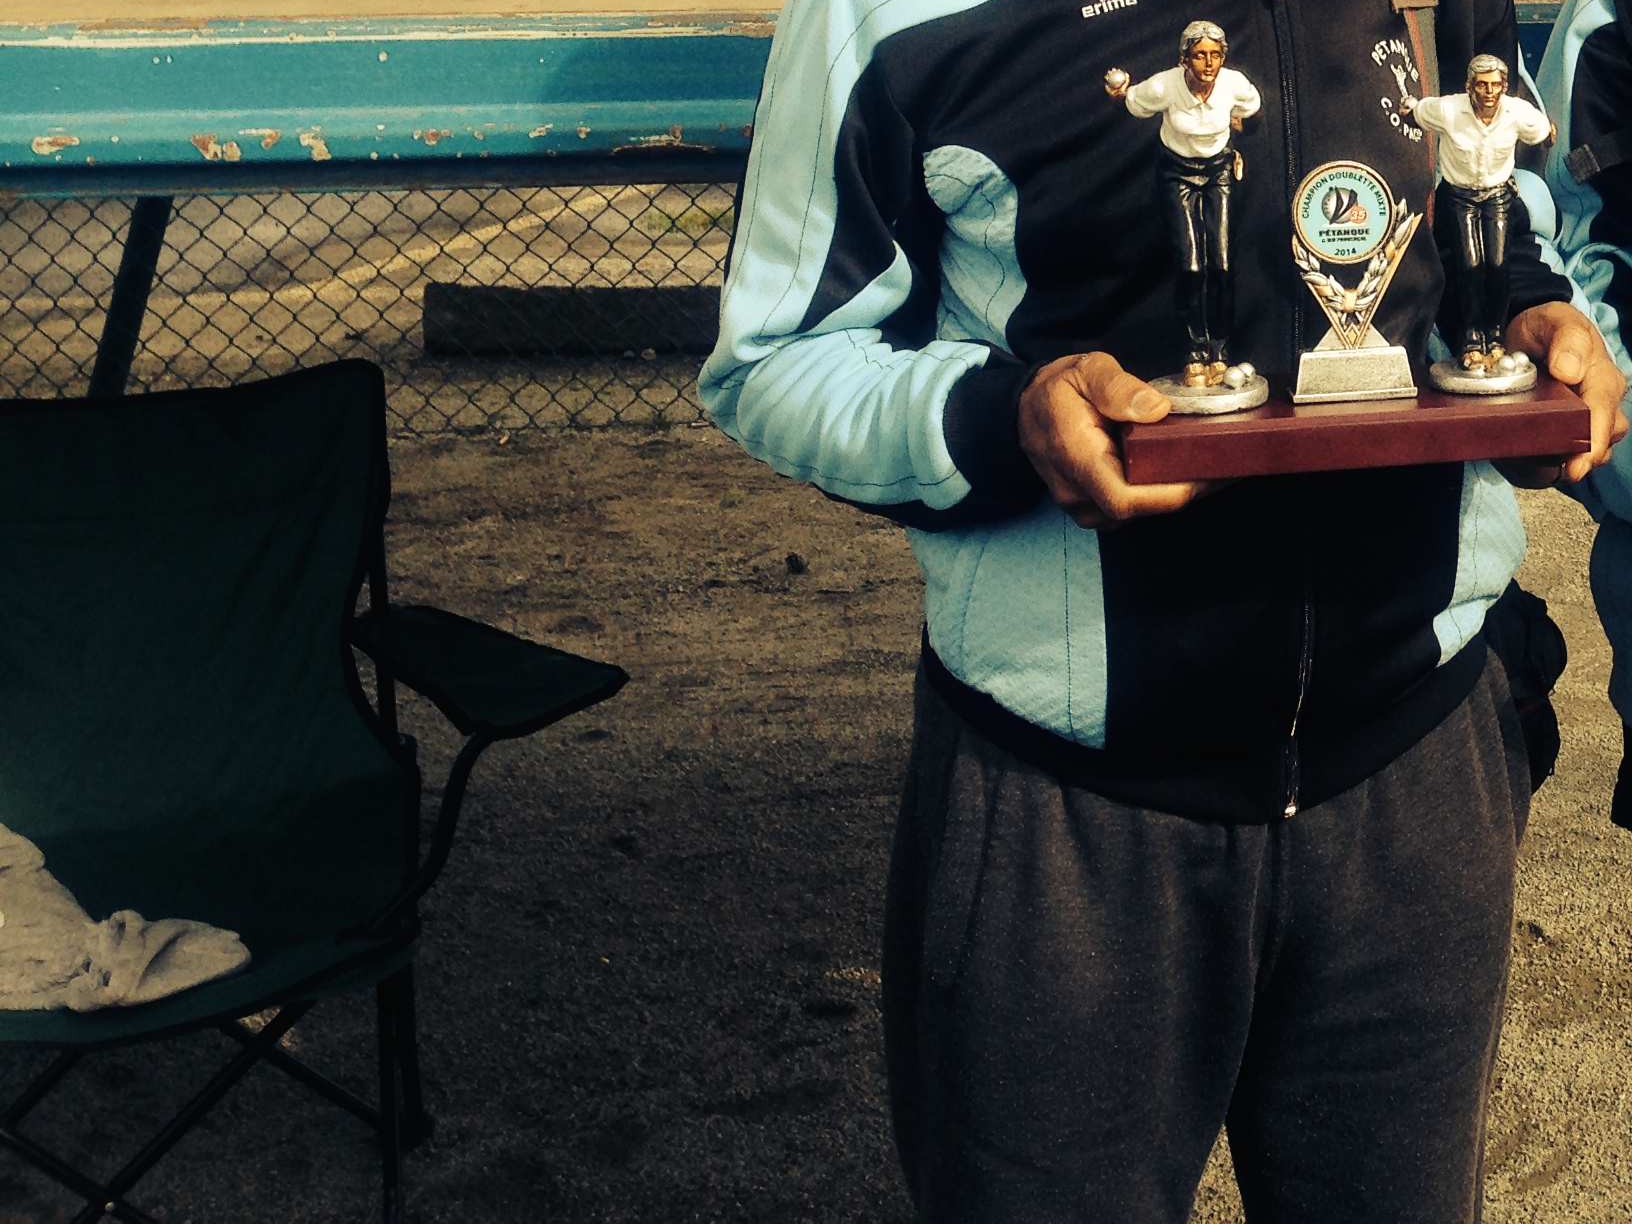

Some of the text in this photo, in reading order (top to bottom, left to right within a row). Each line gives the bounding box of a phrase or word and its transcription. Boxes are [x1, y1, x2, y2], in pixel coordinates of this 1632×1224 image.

[1301, 171, 1388, 220] CHAMPION DOUBLETTE MIXTE
[1350, 210, 1367, 221] 35
[1334, 247, 1358, 257] 2014
